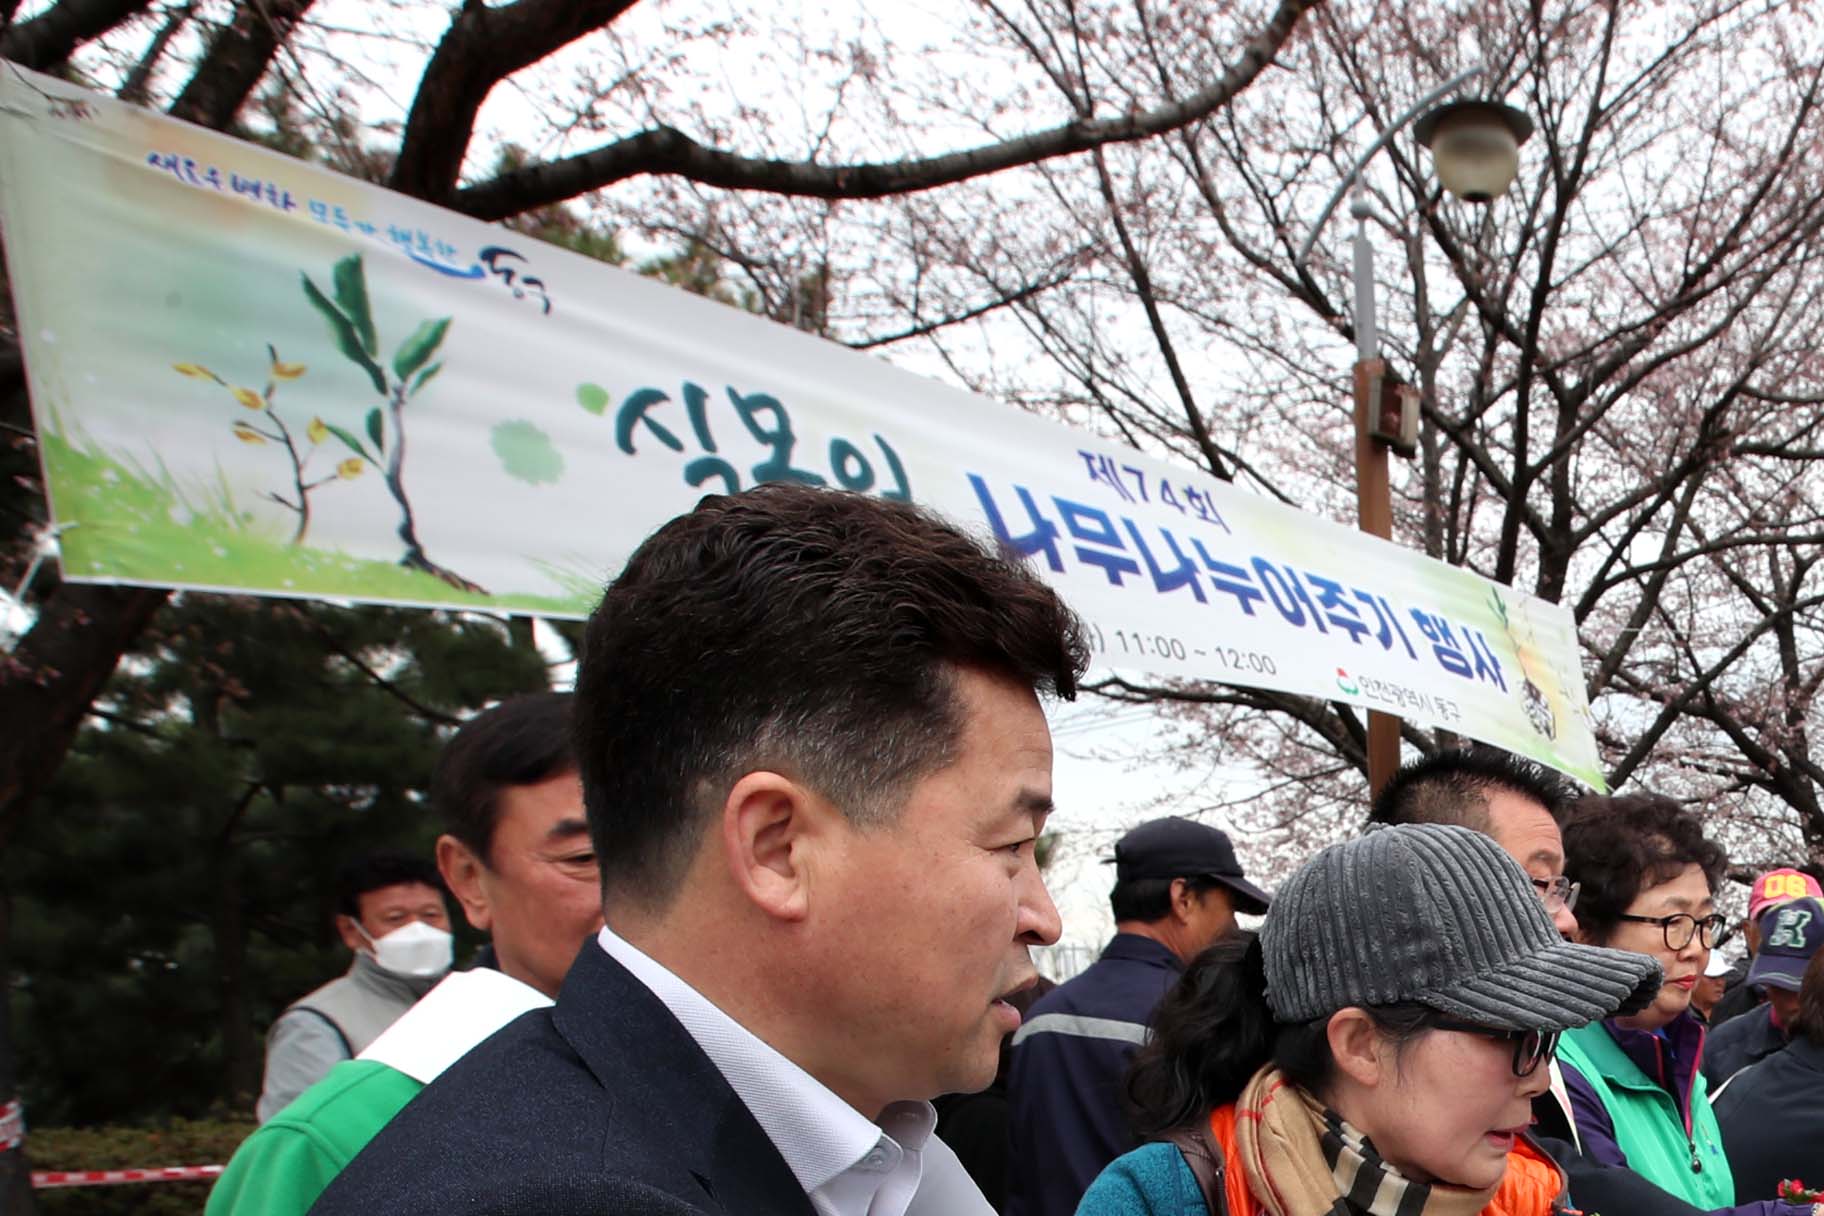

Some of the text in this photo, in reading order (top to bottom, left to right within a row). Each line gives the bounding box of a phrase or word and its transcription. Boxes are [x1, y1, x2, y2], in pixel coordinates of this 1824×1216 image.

[1076, 448, 1232, 535] 제74회
[966, 471, 1509, 694] 나무나누어주기 행사
[1115, 629, 1187, 661] 11:00
[1215, 645, 1278, 676] 12:00
